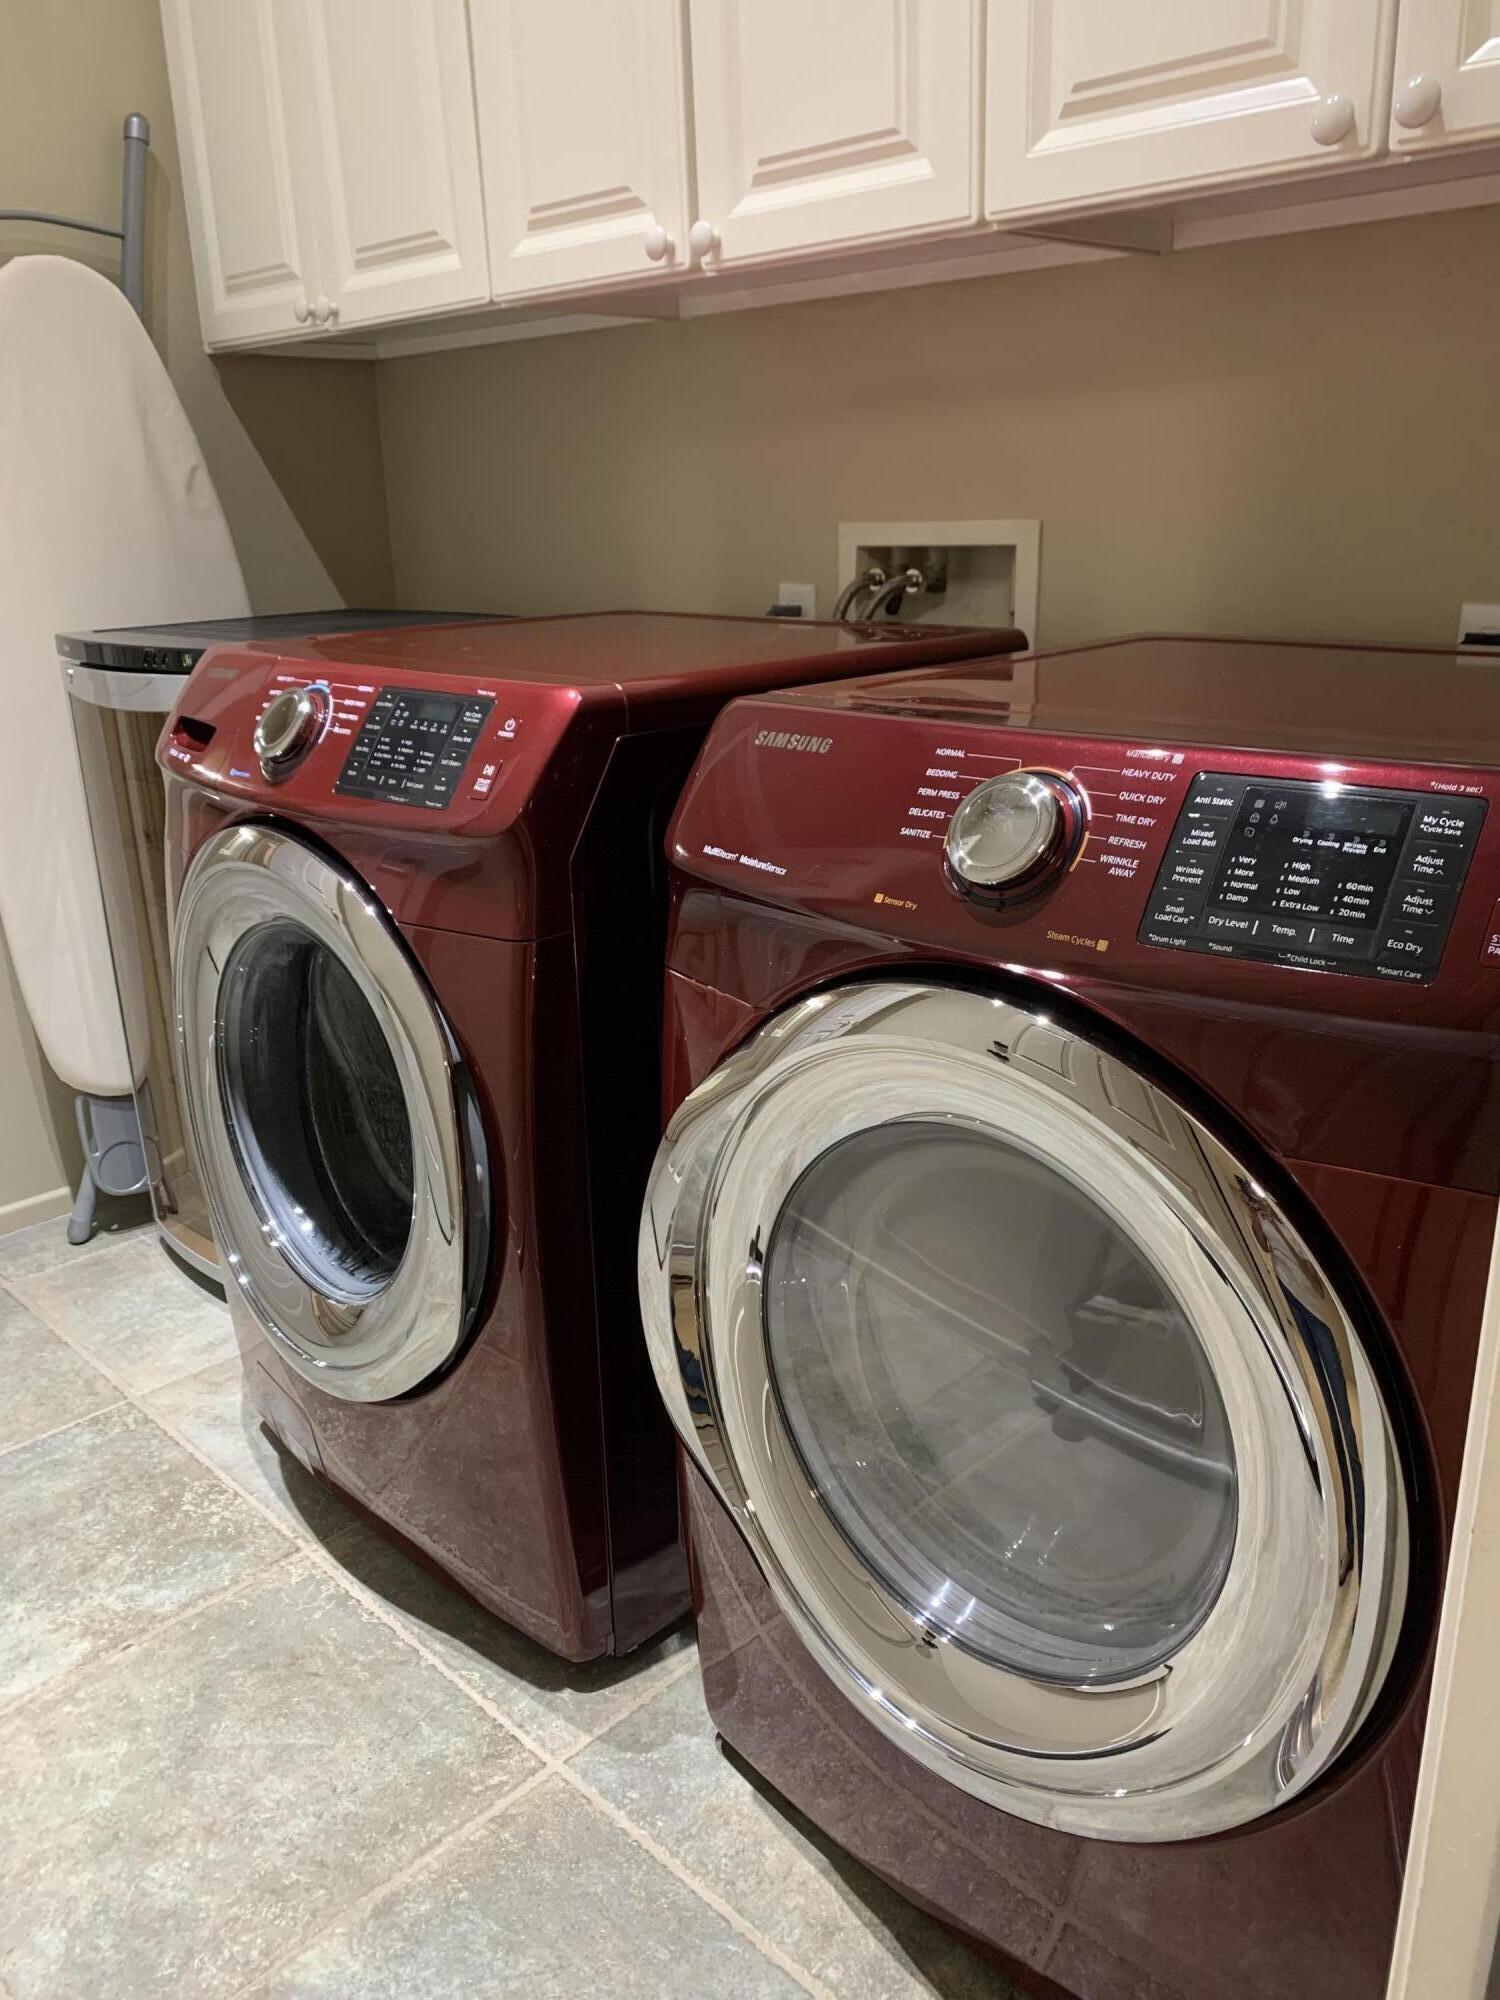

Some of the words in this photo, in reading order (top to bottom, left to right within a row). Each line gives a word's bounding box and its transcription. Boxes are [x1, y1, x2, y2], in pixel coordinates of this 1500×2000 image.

[755, 730, 833, 754] SAMSUNG
[935, 748, 965, 758] NORMAL
[926, 768, 958, 779] BEDDING
[1122, 768, 1151, 779] HEAVY
[1152, 772, 1176, 782] DUTY
[918, 787, 937, 796] PERM
[938, 790, 960, 800] PRESS
[1465, 786, 1483, 794] sec)
[1119, 792, 1145, 803] QUICK
[1146, 795, 1166, 805] DRY
[1194, 796, 1211, 805] Anti
[1211, 797, 1234, 806] Static
[909, 807, 946, 819] DELICATES
[1116, 814, 1137, 824] TIME
[1138, 817, 1156, 827] DRY
[1423, 816, 1438, 825] My
[1440, 817, 1465, 828] Cycle
[900, 827, 932, 838] SANITIZE
[1191, 829, 1214, 838] Mixed
[1444, 827, 1462, 836] Save
[1108, 836, 1147, 850] REFRESH
[1202, 839, 1216, 847] Bell
[1292, 836, 1313, 845] Drying
[1317, 839, 1340, 848] Cooling
[1373, 846, 1386, 854] End
[1100, 854, 1139, 869] WRINKLE
[1238, 856, 1257, 865] Very
[1415, 855, 1444, 866] Adjust
[1176, 866, 1204, 875] Wrinkle
[1234, 868, 1254, 876] More
[1292, 862, 1311, 871] High
[1413, 864, 1435, 874] Time
[1108, 867, 1135, 878] AWAY
[1172, 874, 1201, 884] Prevent
[1288, 875, 1320, 885] Medium
[1230, 881, 1258, 891] Normal
[1284, 887, 1300, 896] Low
[1346, 883, 1374, 893] 60min
[884, 896, 904, 906] Sensor
[905, 900, 918, 910] Dry
[1226, 893, 1248, 903] Damp
[1342, 896, 1370, 906] 40min
[1404, 894, 1434, 906] Adjust
[1165, 905, 1184, 913] Small
[1280, 900, 1300, 909] Extra
[1302, 903, 1320, 912] Low
[1402, 904, 1423, 915] Time
[1155, 913, 1171, 921] Load
[1338, 908, 1366, 919] 20min
[1208, 916, 1224, 926] Dry
[1225, 918, 1248, 929] Level
[1272, 924, 1297, 937] Temp.
[1047, 930, 1070, 942] Steam
[1071, 936, 1096, 947] Cycles
[1169, 935, 1186, 946] Light
[1332, 933, 1355, 945] Time
[1387, 940, 1404, 949] Eco
[1405, 942, 1423, 953] Dry
[1309, 957, 1326, 966] Lock
[1404, 970, 1422, 979] Care
